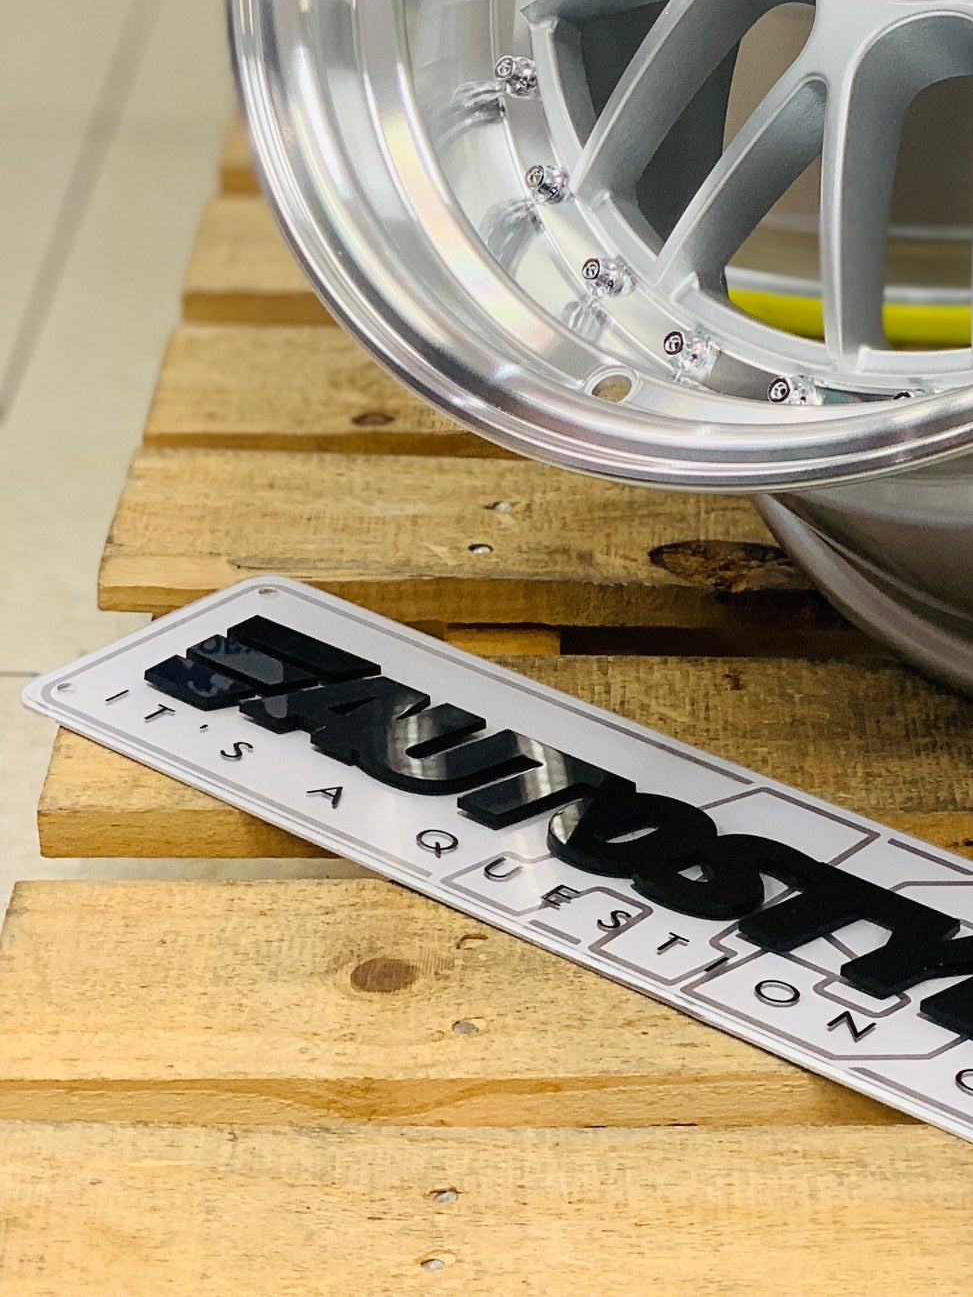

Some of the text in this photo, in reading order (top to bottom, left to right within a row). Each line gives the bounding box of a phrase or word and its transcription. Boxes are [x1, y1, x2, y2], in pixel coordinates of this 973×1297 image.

[104, 689, 253, 763] IT'S
[306, 784, 344, 809] A
[416, 827, 876, 1045] QUESTION
